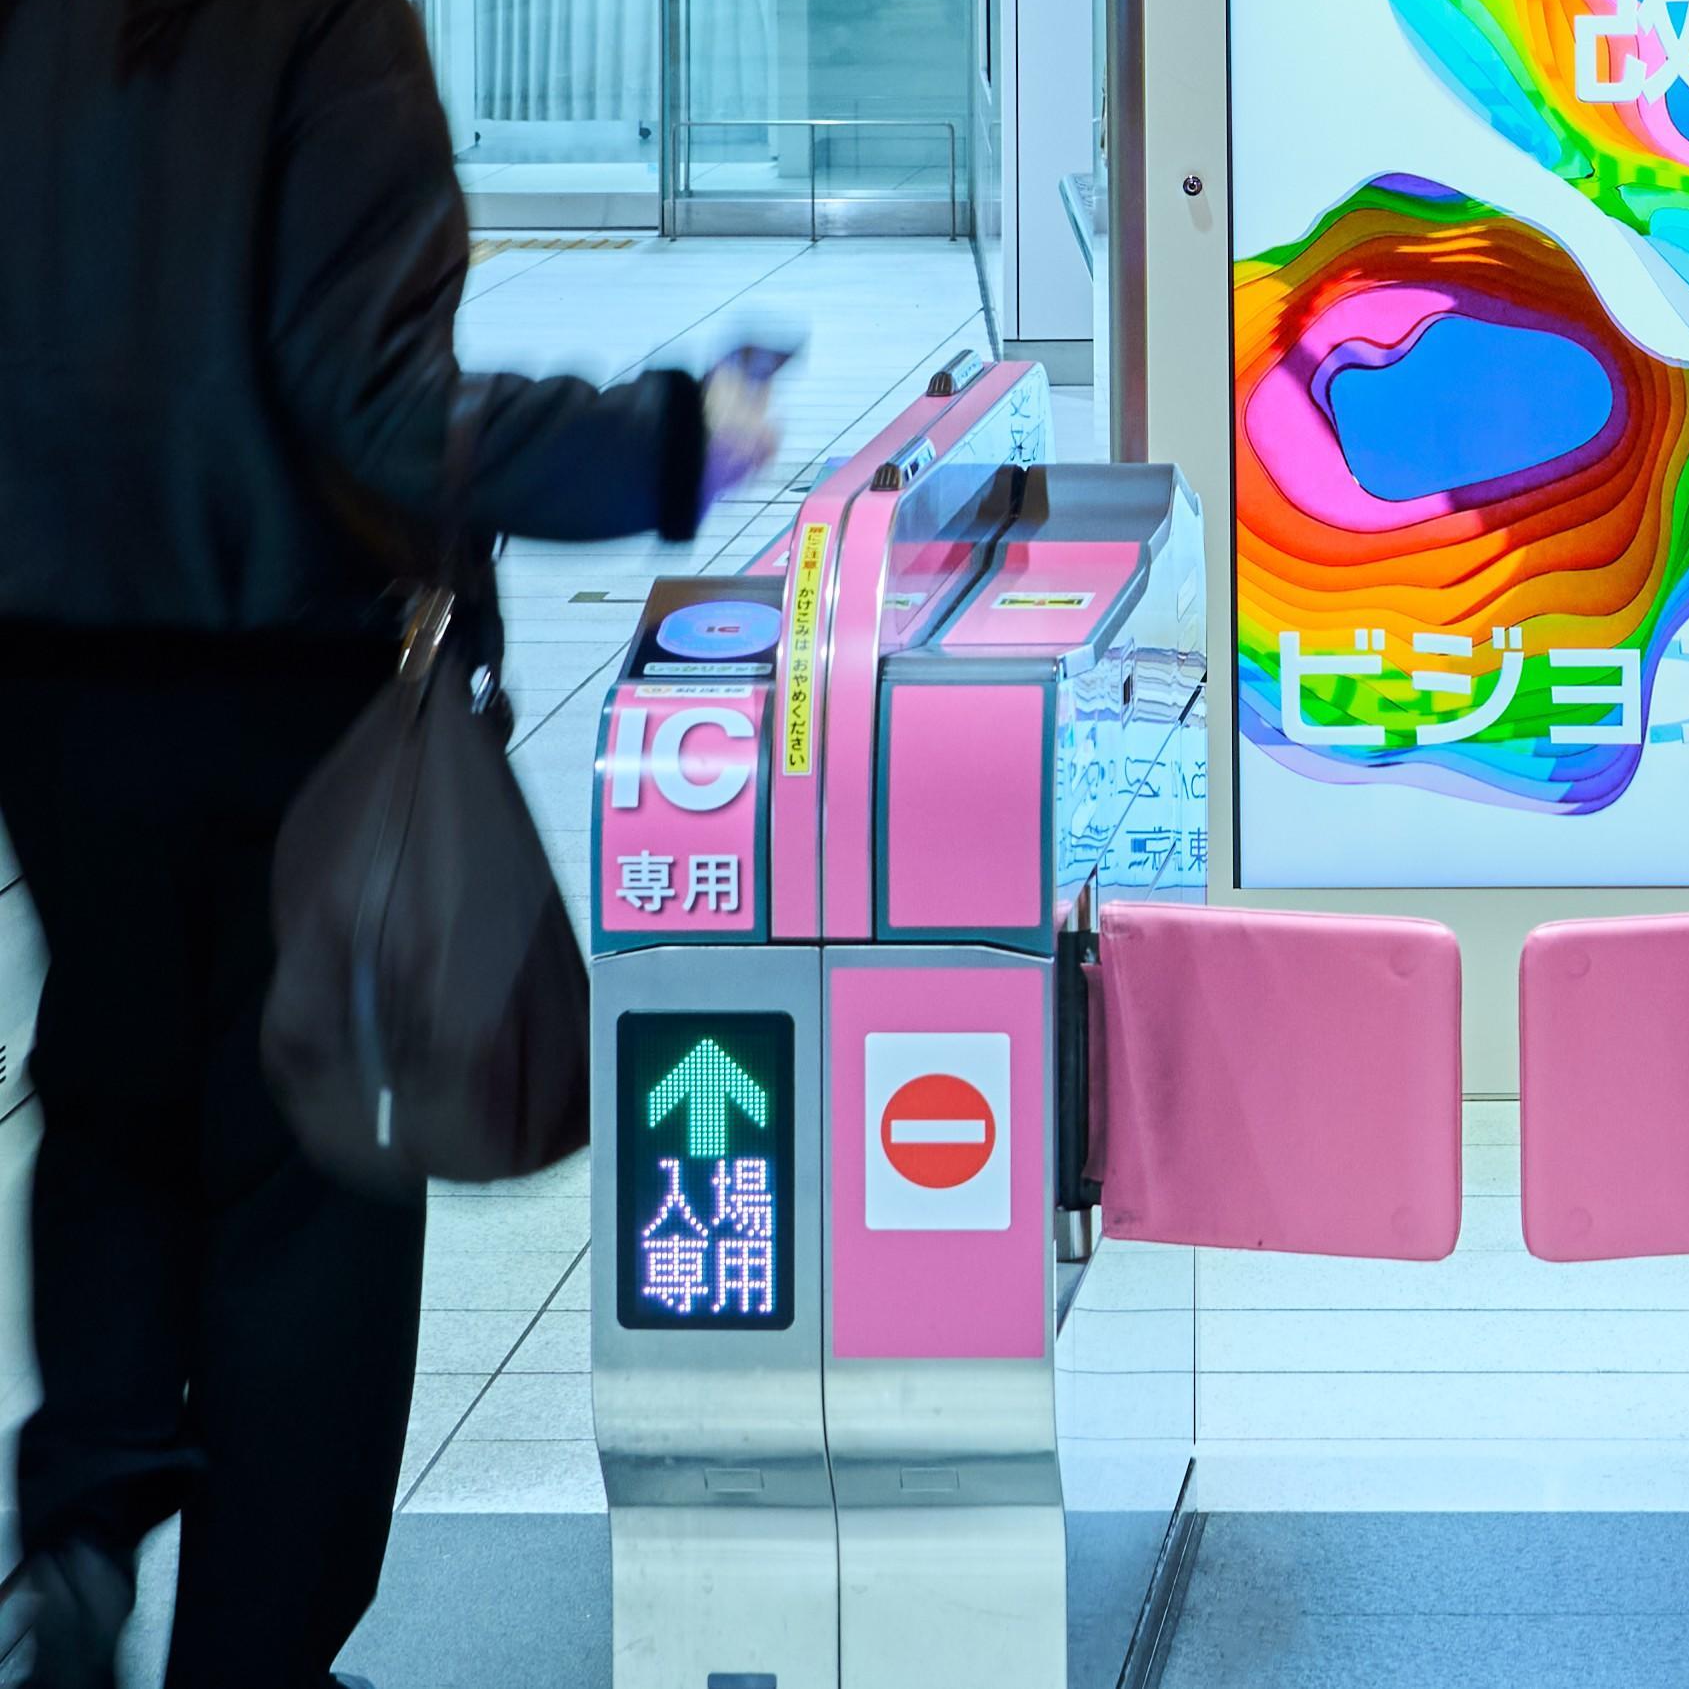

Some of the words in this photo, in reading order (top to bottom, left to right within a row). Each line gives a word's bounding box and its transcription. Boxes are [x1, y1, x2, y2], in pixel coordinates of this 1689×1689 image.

[794, 587, 815, 651] かけこみは
[789, 658, 809, 766] おやめください
[611, 707, 755, 812] IC
[615, 850, 739, 912] 専用
[643, 1159, 772, 1237] 入場
[643, 1234, 772, 1313] 専用
